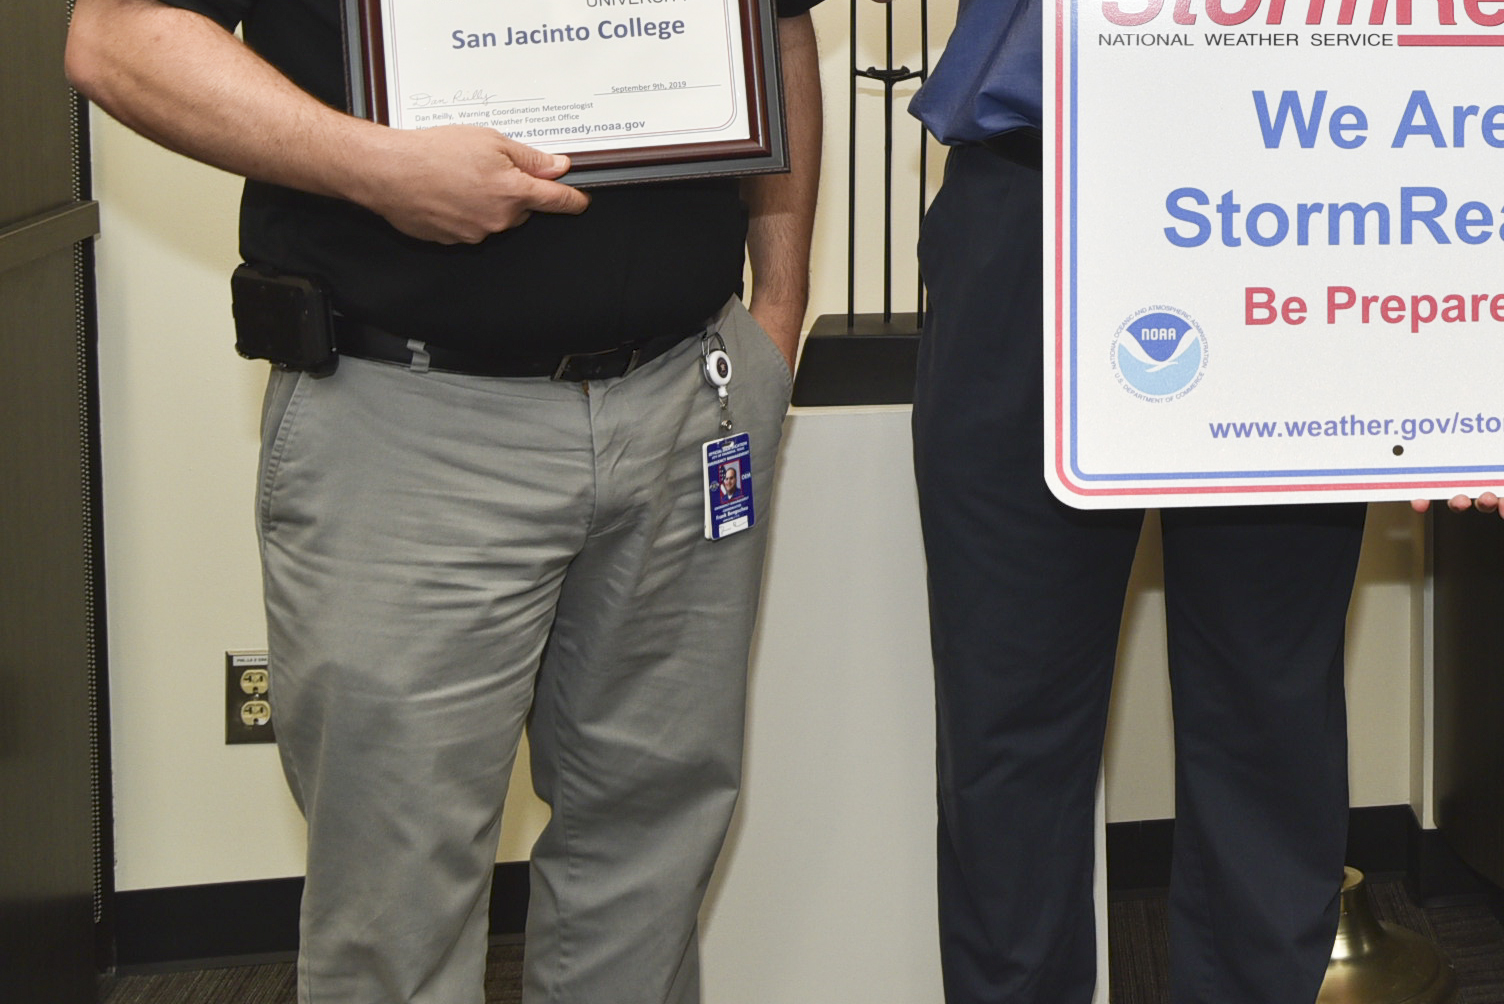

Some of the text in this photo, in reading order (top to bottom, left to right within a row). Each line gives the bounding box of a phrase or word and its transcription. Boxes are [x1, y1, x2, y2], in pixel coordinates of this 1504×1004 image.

[452, 17, 685, 50] San Jacinto College
[1098, 34, 1394, 46] NATIONAL WEATHER SERVICE
[611, 80, 687, 94] September 9th, 2019
[415, 114, 430, 122] Dan
[458, 110, 490, 118] Warning
[492, 105, 540, 116] Coordination
[542, 102, 594, 112] Meteorologist
[490, 118, 524, 126] Weather
[524, 115, 556, 124] Forecast
[1252, 90, 1368, 150] We
[502, 120, 646, 139] ww.stormready.noaa.gov
[1134, 308, 1148, 317] AND
[1148, 304, 1192, 320] ATMOSPHERIC
[1244, 287, 1308, 326] Be
[1142, 328, 1176, 340] NOAA
[1123, 384, 1164, 404] DEPARTMENT
[1176, 372, 1204, 400] COMMERCE
